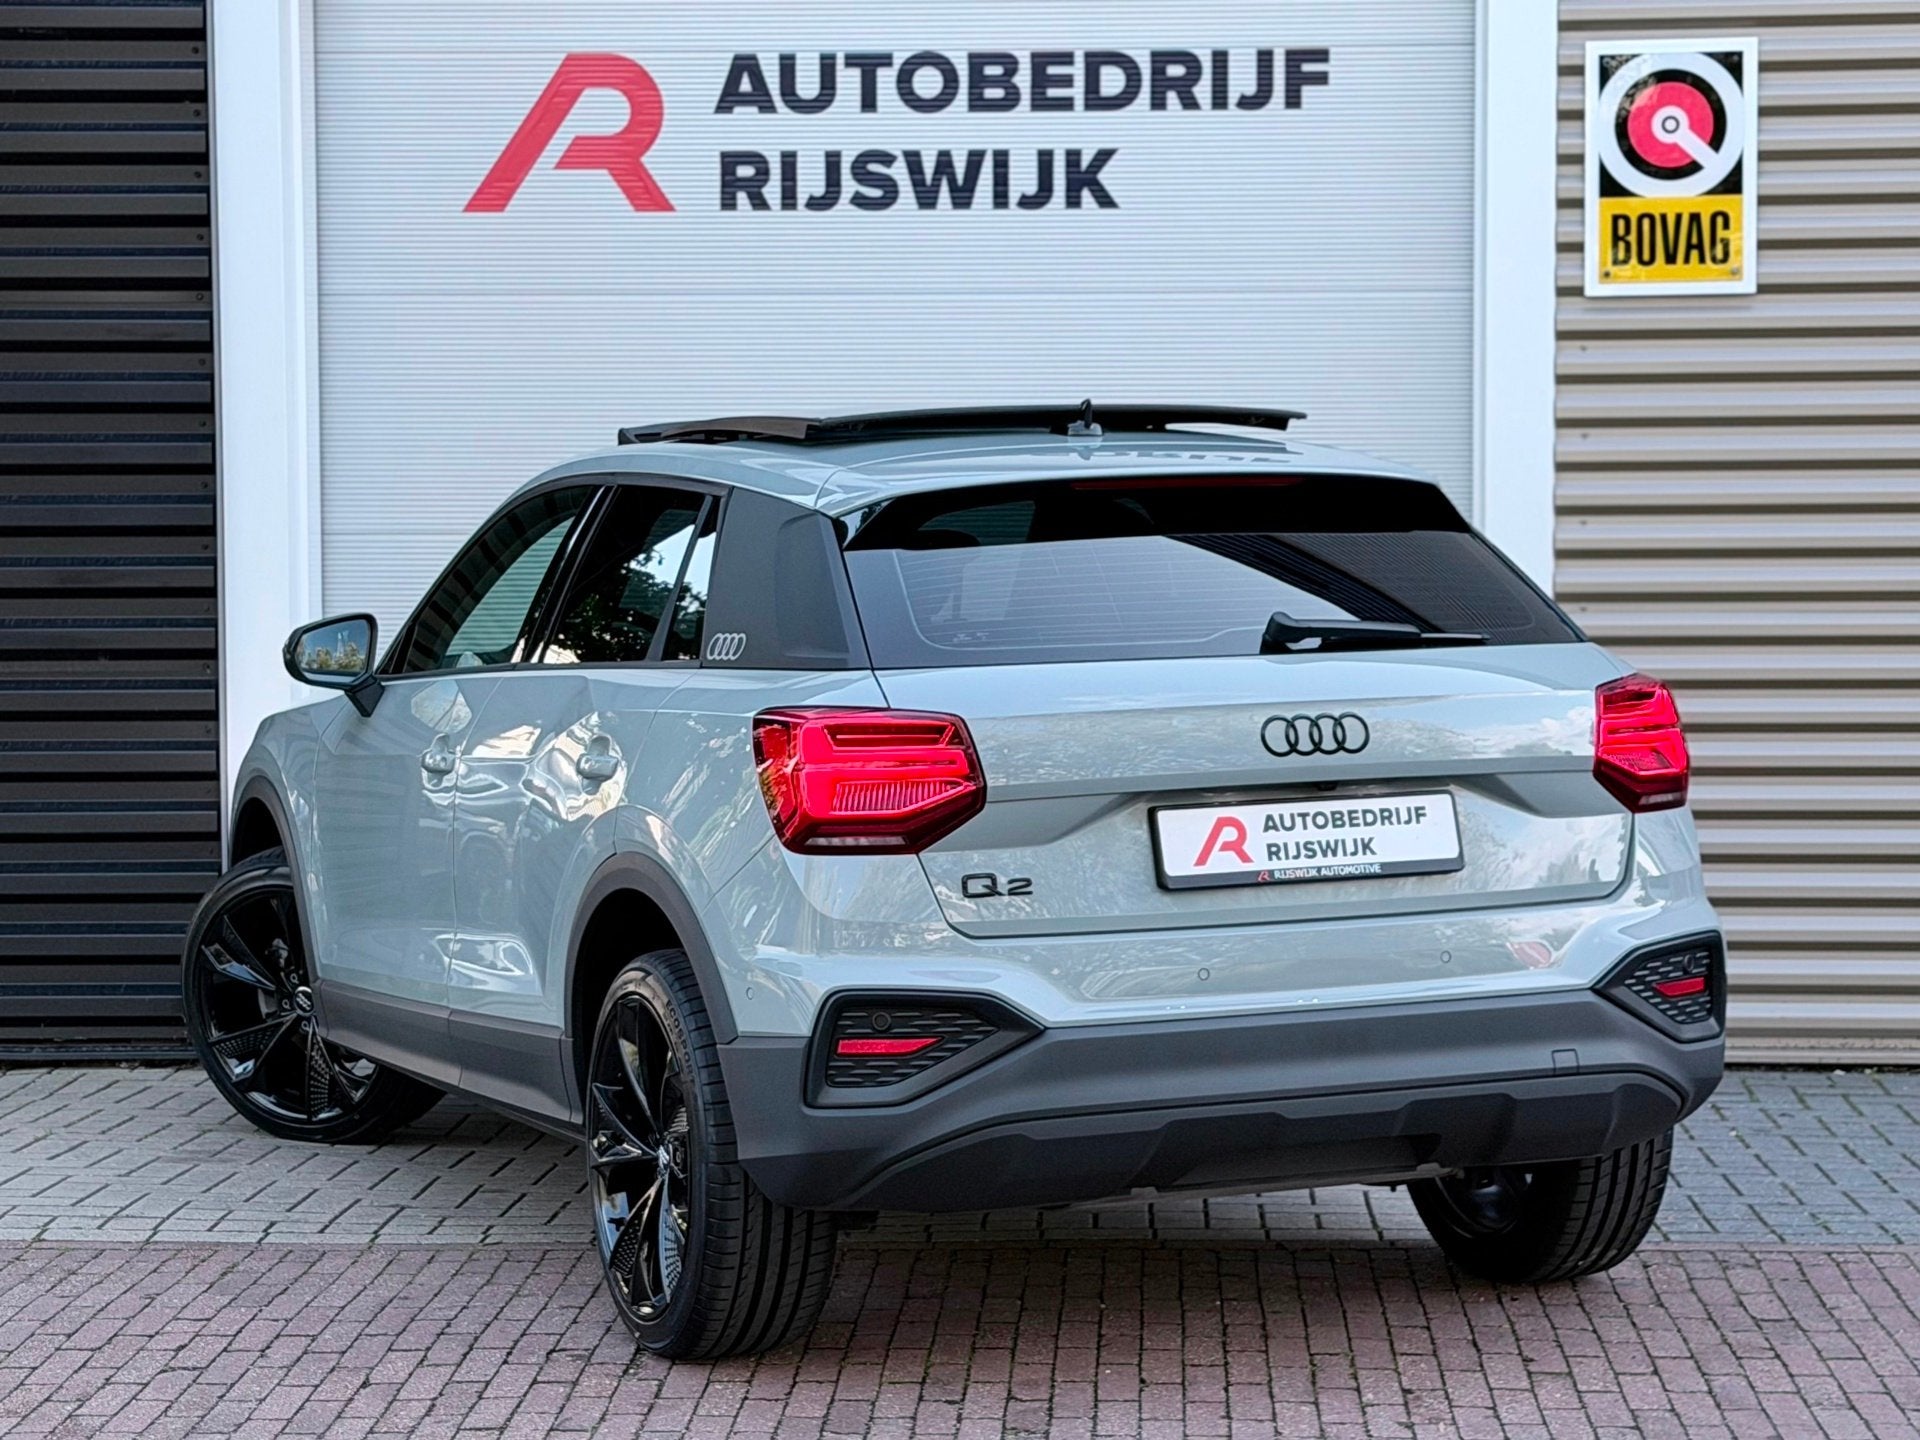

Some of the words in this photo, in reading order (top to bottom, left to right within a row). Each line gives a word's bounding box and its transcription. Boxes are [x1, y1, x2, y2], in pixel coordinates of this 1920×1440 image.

[714, 48, 1330, 114] AUTOBEDRIJF
[719, 149, 1120, 211] RIJSWIJK
[1611, 211, 1730, 266] BOVAG
[1262, 806, 1427, 833] AUTOBEDRIJF
[1266, 837, 1377, 862] RIJSWIJK
[961, 872, 1033, 898] Q2
[1273, 867, 1319, 880] RIJSWIJK
[1320, 863, 1382, 876] AUTOMOTIVE
